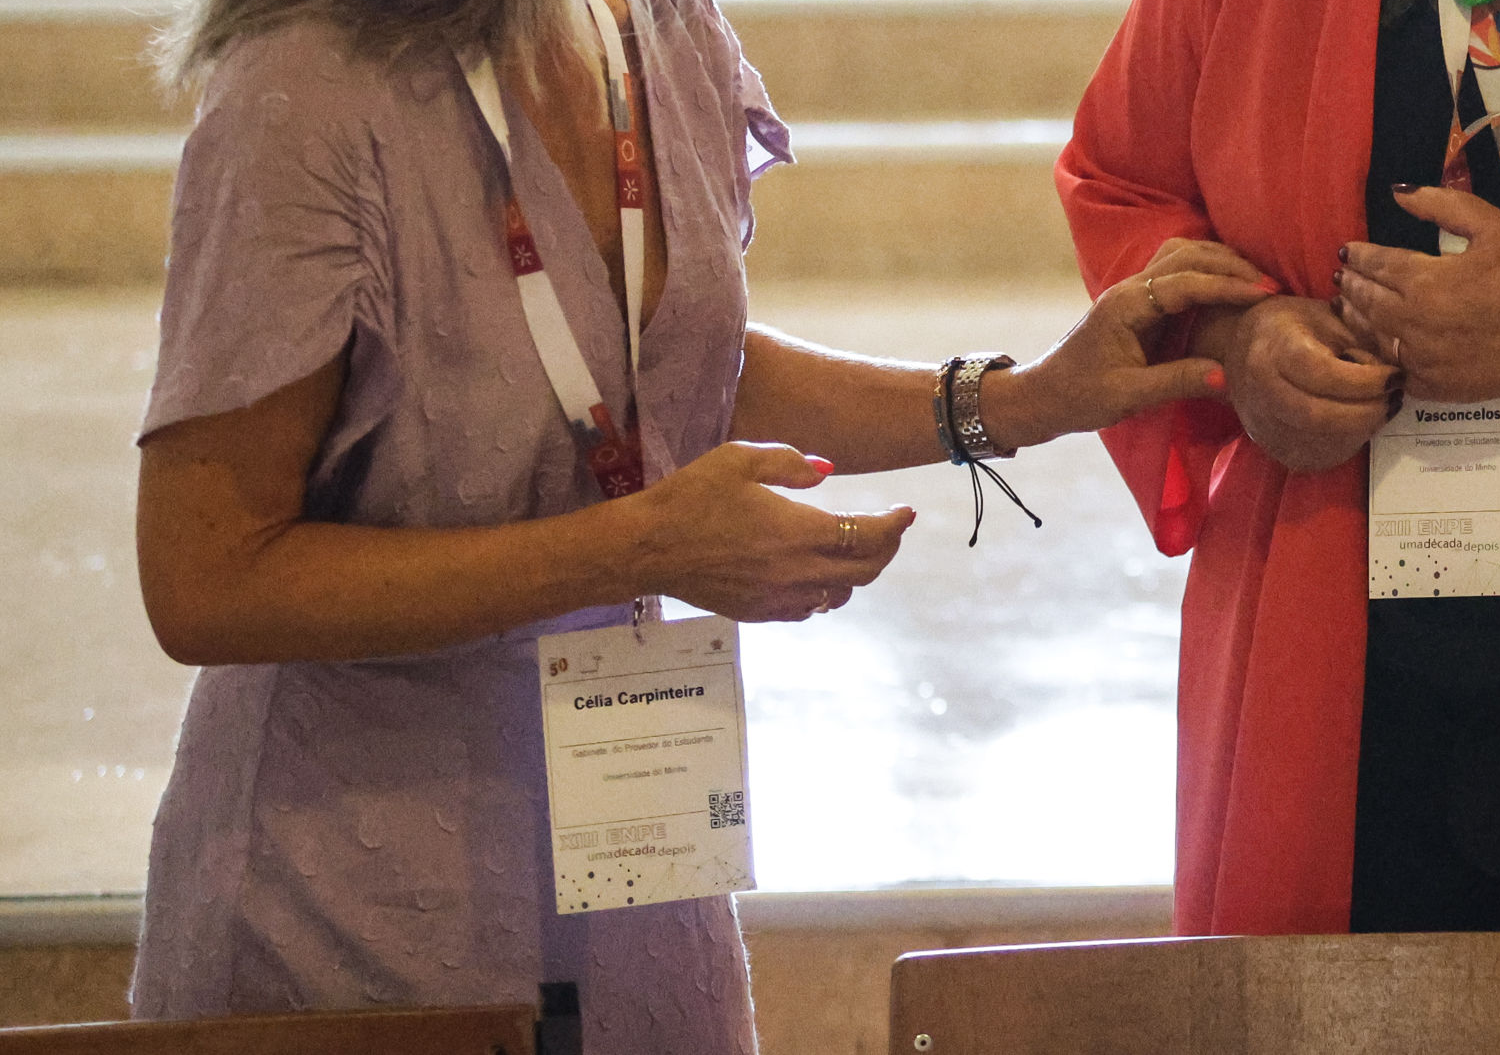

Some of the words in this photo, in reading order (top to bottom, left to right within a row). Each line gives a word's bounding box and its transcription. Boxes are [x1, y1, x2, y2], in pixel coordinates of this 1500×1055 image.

[1415, 407, 1500, 422] Vasconcelos
[1374, 520, 1411, 537] XIII
[1417, 518, 1473, 536] ENPE
[574, 694, 613, 710] Célia
[617, 685, 705, 705] Carpinteira
[559, 831, 599, 851] XIII
[606, 823, 667, 845] ENPE
